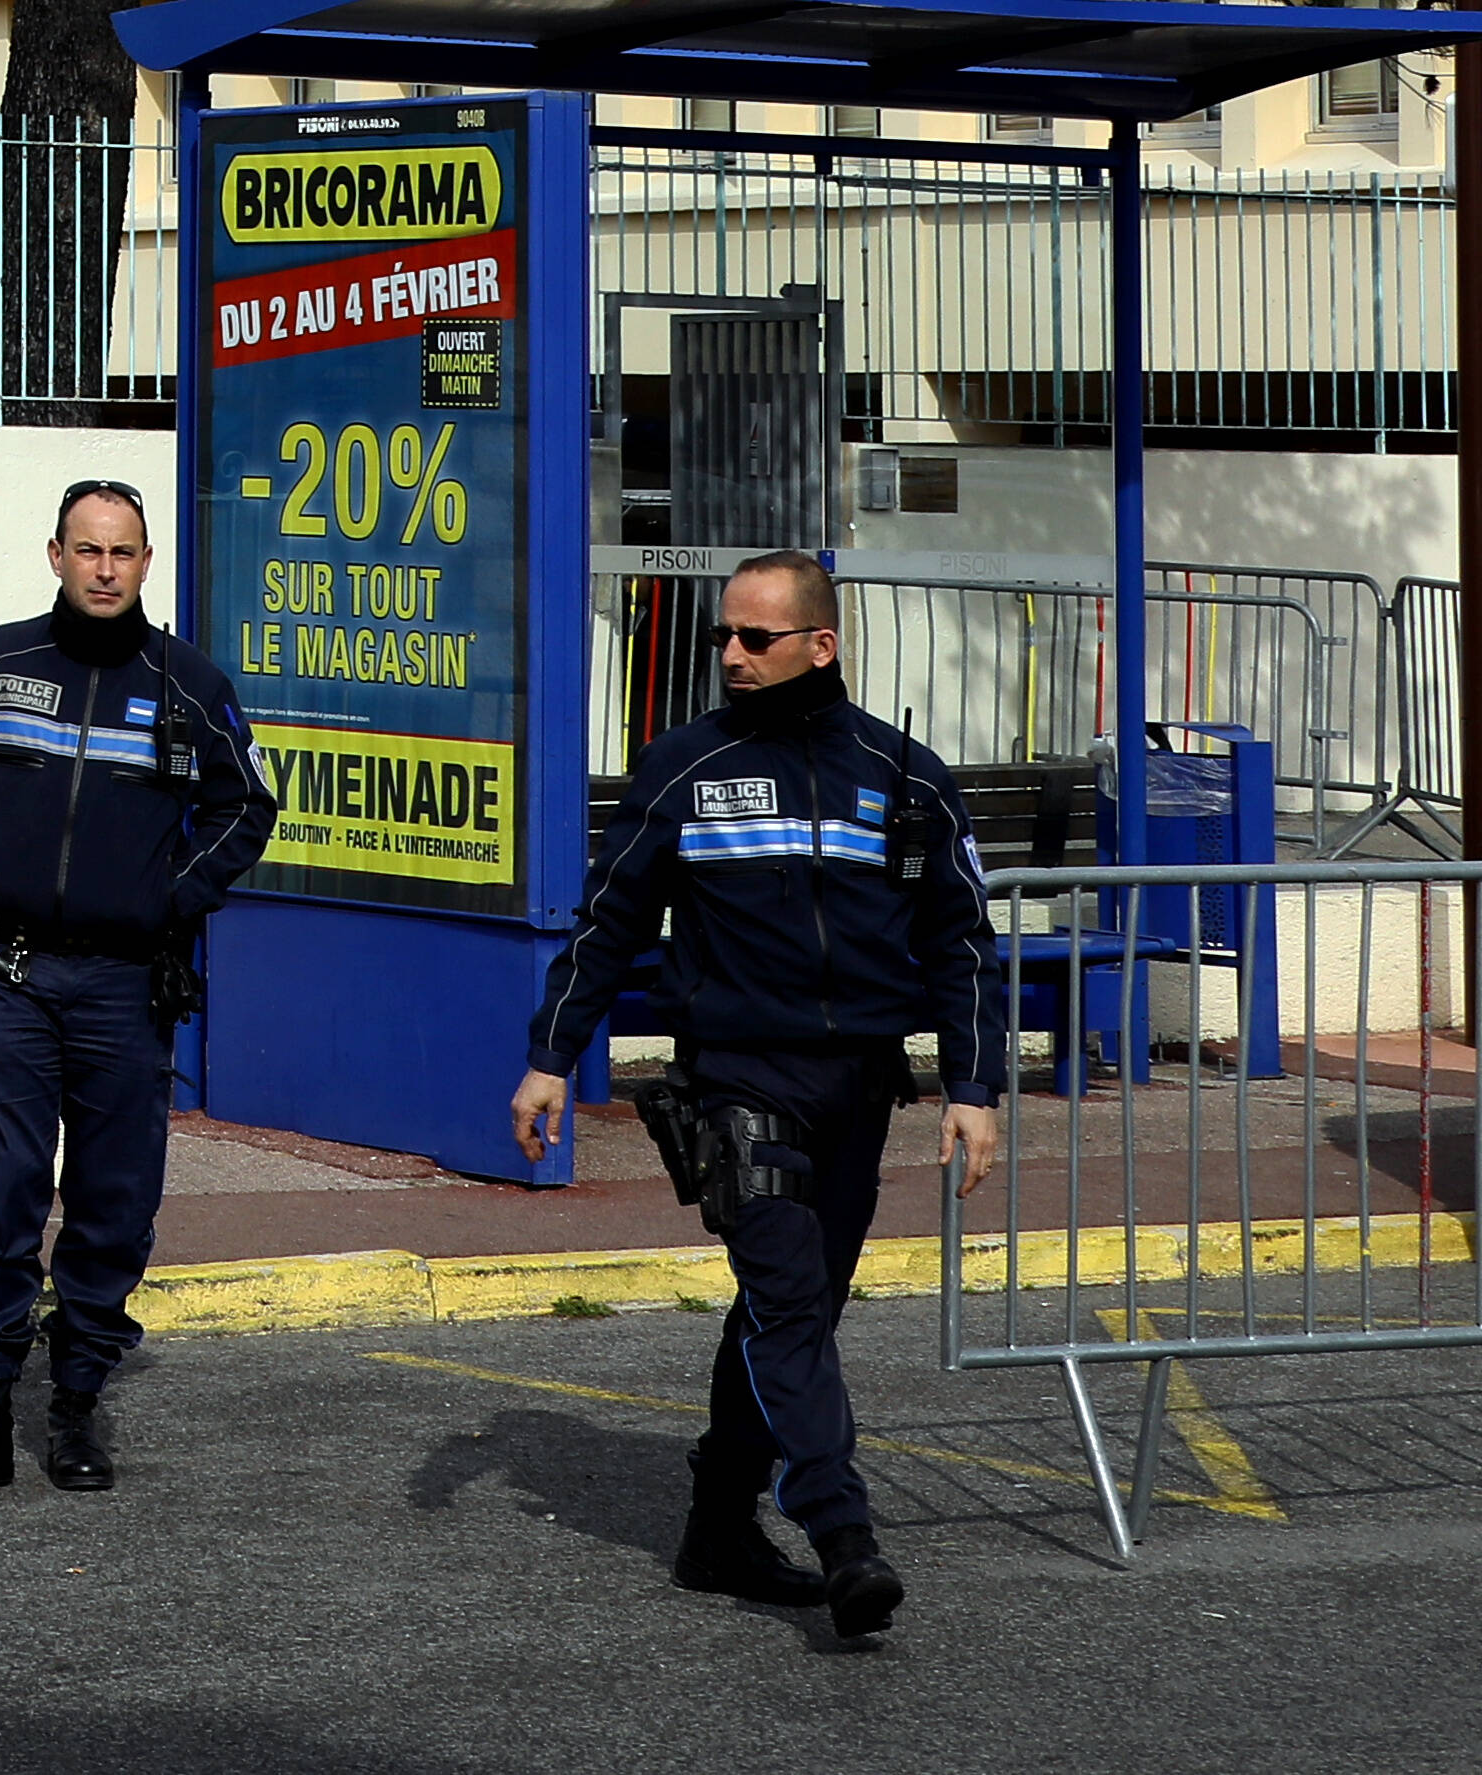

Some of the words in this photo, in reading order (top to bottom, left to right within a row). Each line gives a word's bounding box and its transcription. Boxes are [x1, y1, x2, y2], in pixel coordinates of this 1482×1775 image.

[297, 117, 340, 134] PISONI
[236, 161, 487, 230] BRICORAMA
[220, 299, 262, 349] DU
[268, 295, 288, 341] 2
[294, 285, 337, 337] AU
[344, 282, 364, 326] 4
[371, 257, 501, 323] FÉVRIER
[437, 331, 487, 351] OUVERT
[428, 353, 495, 374] DIMANCHE
[441, 375, 482, 396] MATIN
[240, 421, 468, 546] -20%
[641, 549, 712, 570] PISONI
[939, 553, 1009, 576] PISONI
[263, 558, 335, 616] SUR
[346, 562, 442, 622] TOUT
[241, 621, 282, 675] LE
[260, 746, 499, 833] YMEINADE
[702, 783, 769, 801] POLICE
[702, 798, 770, 813] MUNICIPALE
[279, 821, 332, 846] BOUTINY
[346, 828, 379, 851] FACE
[381, 827, 392, 853] À
[395, 834, 500, 865] L'INTERMARCHÉ
